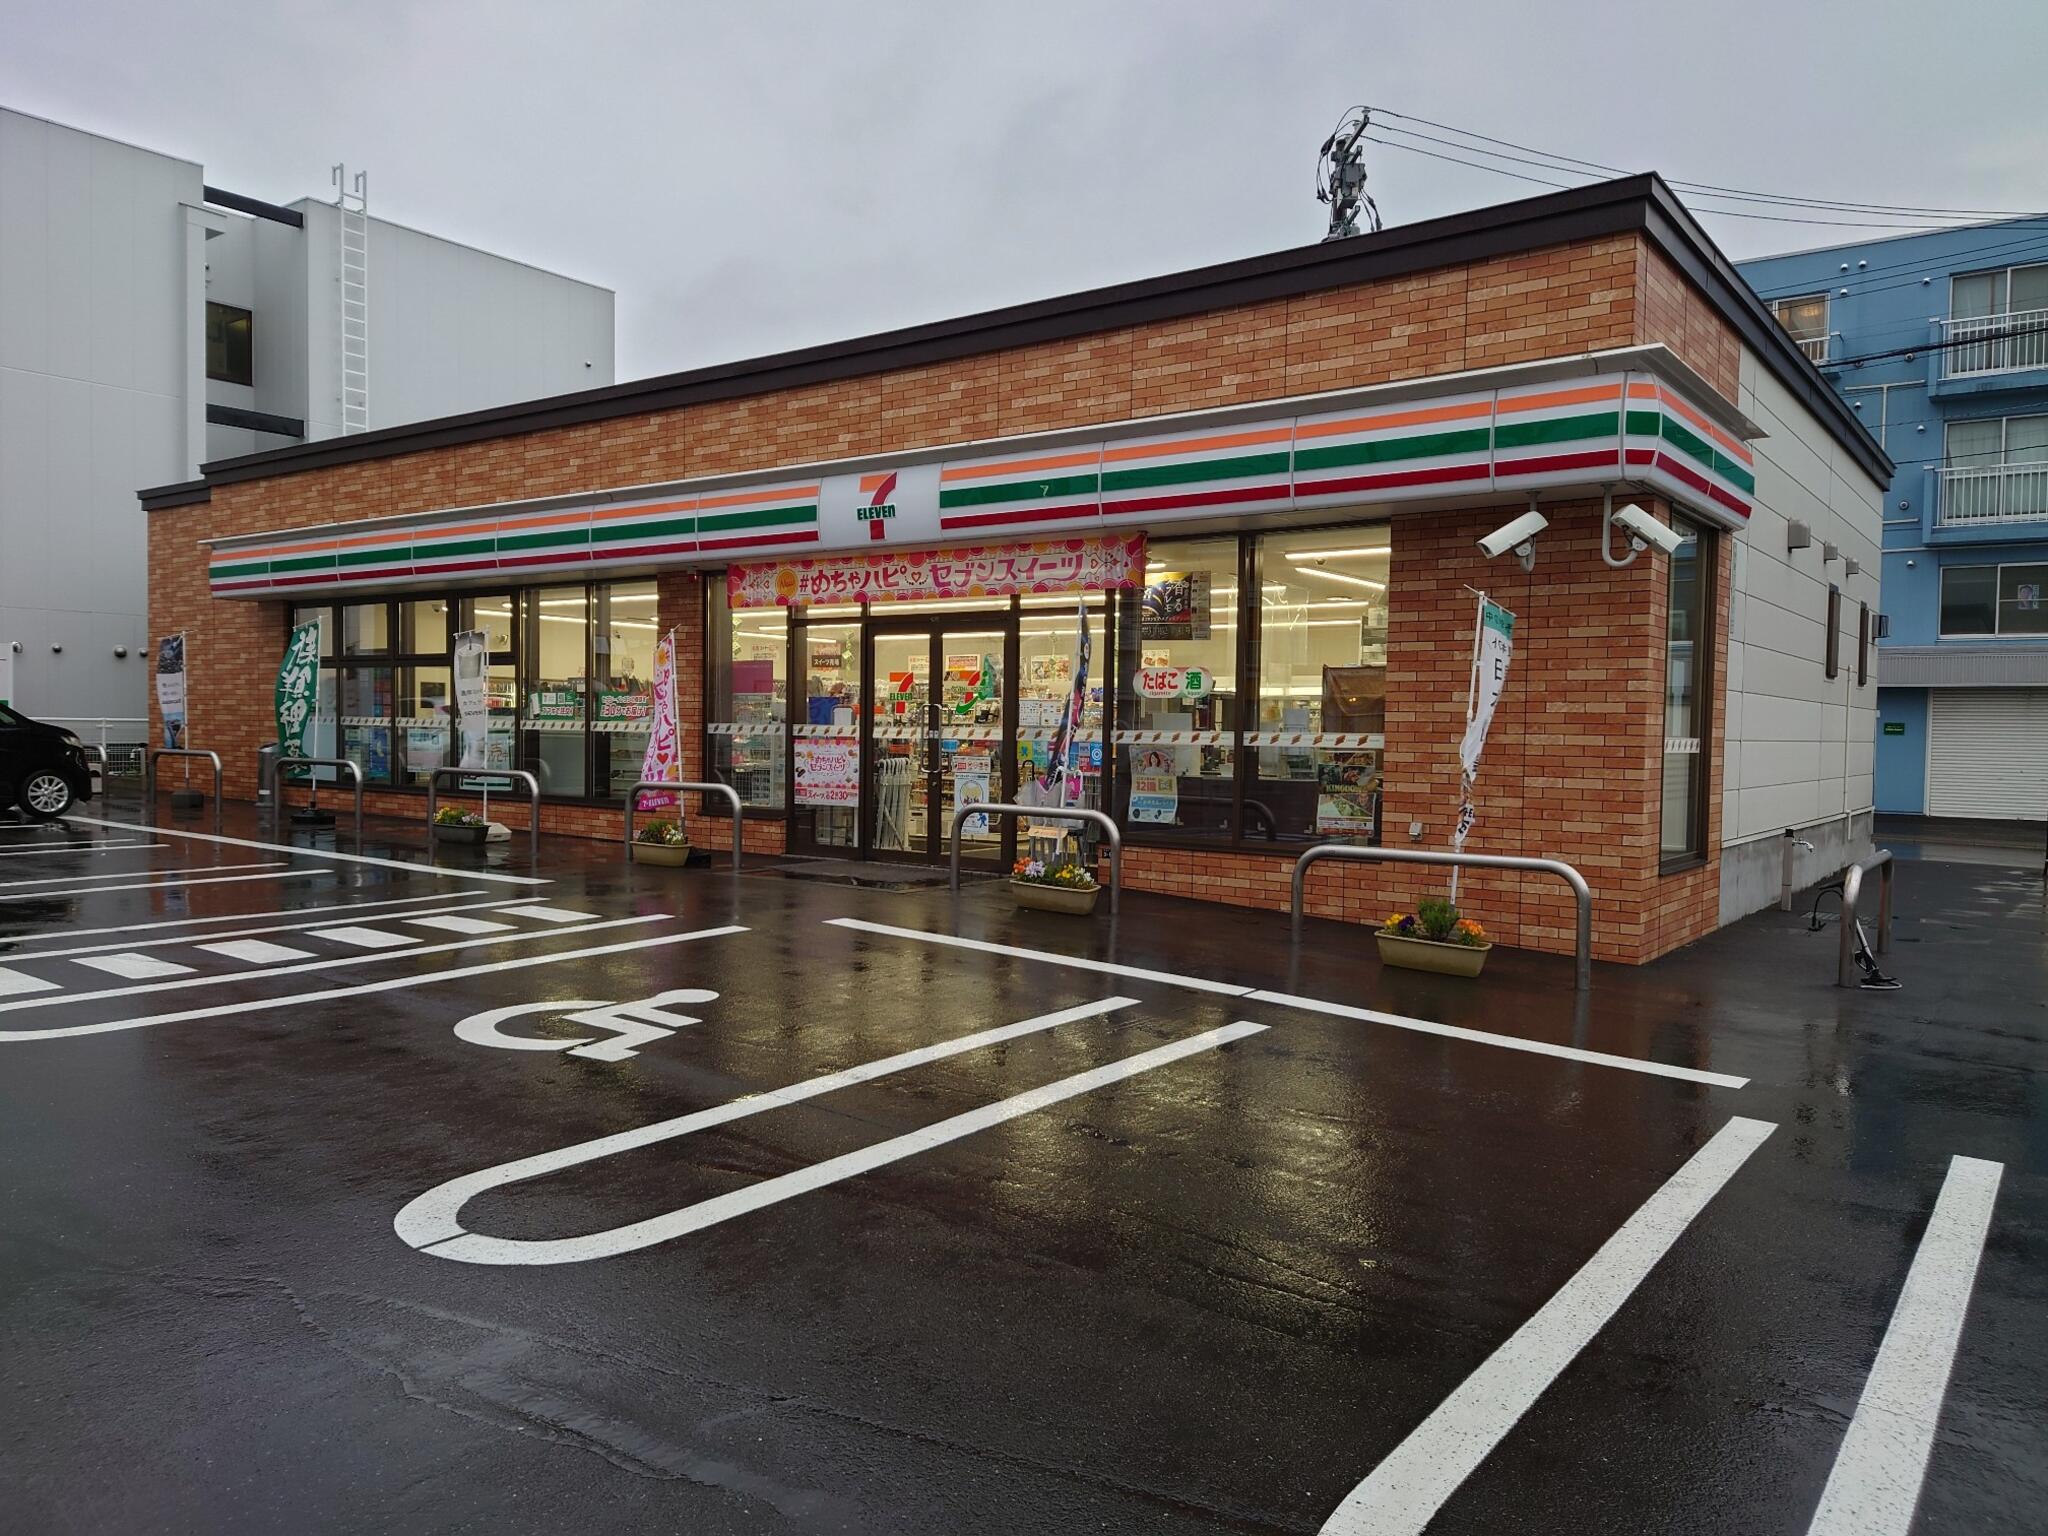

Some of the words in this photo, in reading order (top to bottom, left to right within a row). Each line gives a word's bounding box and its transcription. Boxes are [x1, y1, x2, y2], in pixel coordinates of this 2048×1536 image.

[929, 553, 1084, 588] セブンスイーツ
[1142, 671, 1178, 690] たばこ
[1185, 671, 1202, 690] 酒
